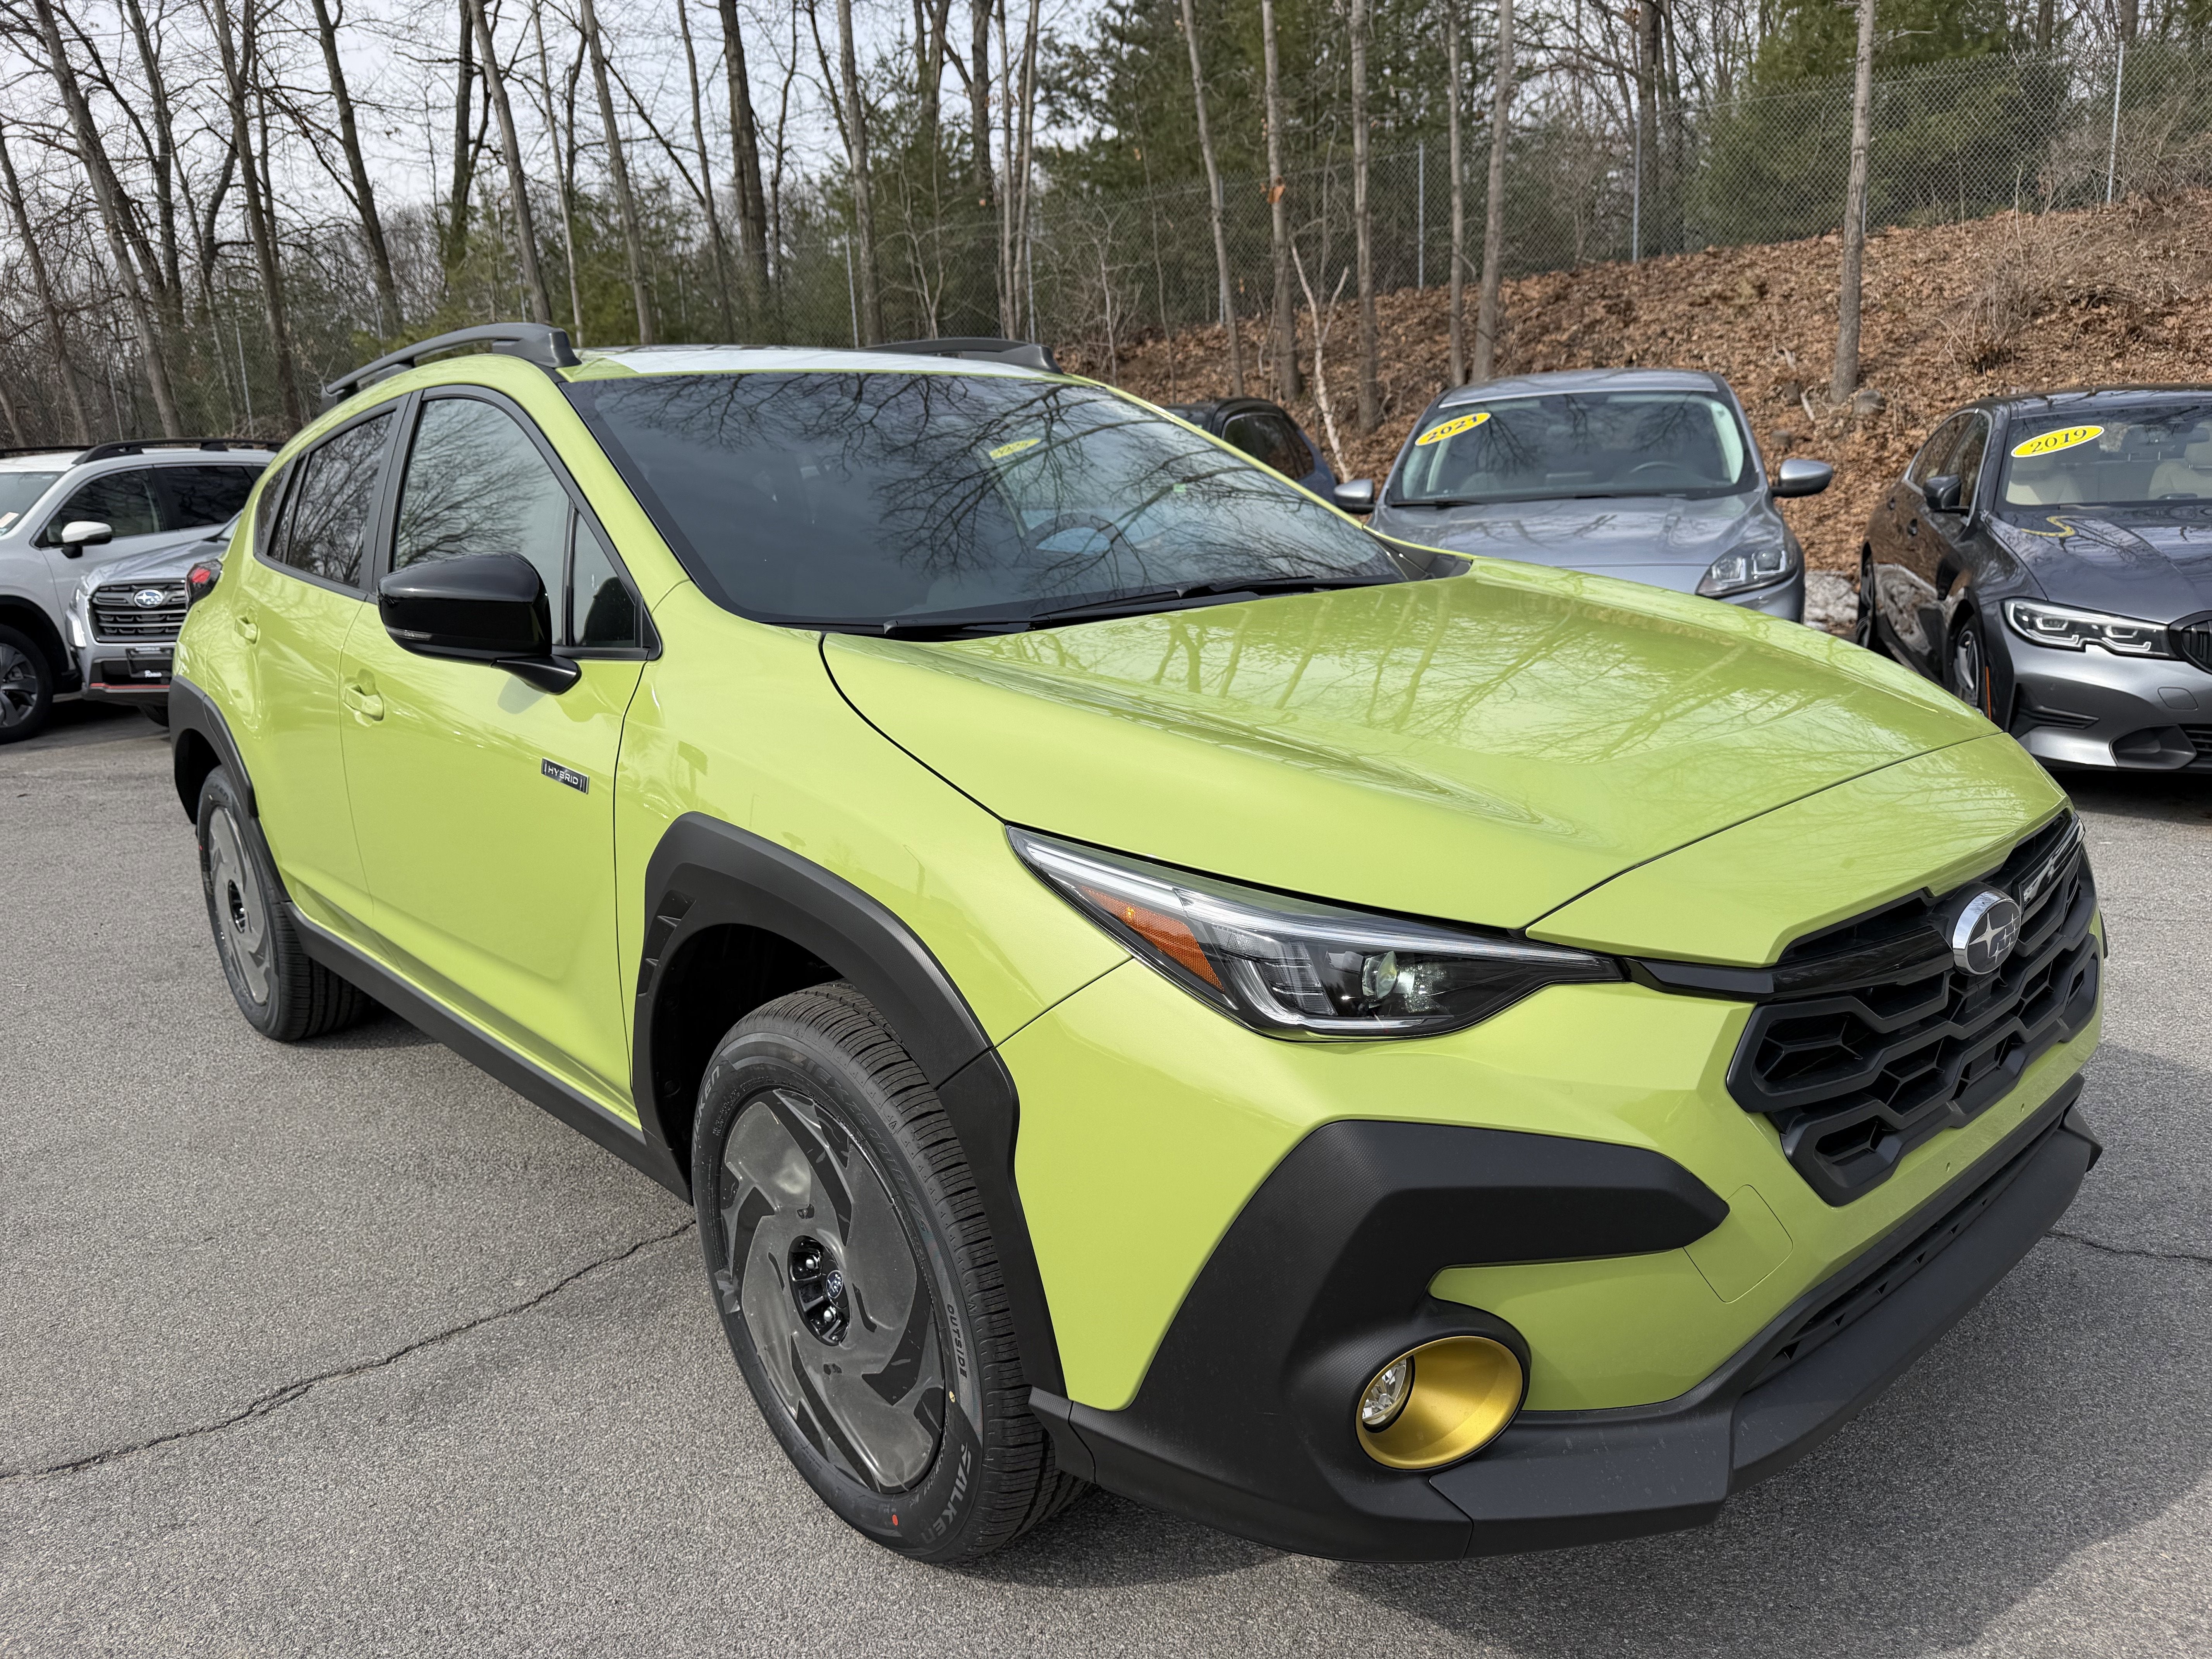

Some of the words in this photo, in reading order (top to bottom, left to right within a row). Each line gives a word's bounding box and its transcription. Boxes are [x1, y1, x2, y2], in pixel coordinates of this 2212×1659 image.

[1426, 416, 1477, 441] 2021
[2030, 429, 2087, 454] 2019
[548, 766, 579, 785] HYBRID
[947, 1304, 967, 1378] OUTSIDE
[921, 1442, 972, 1544] FALKEN
